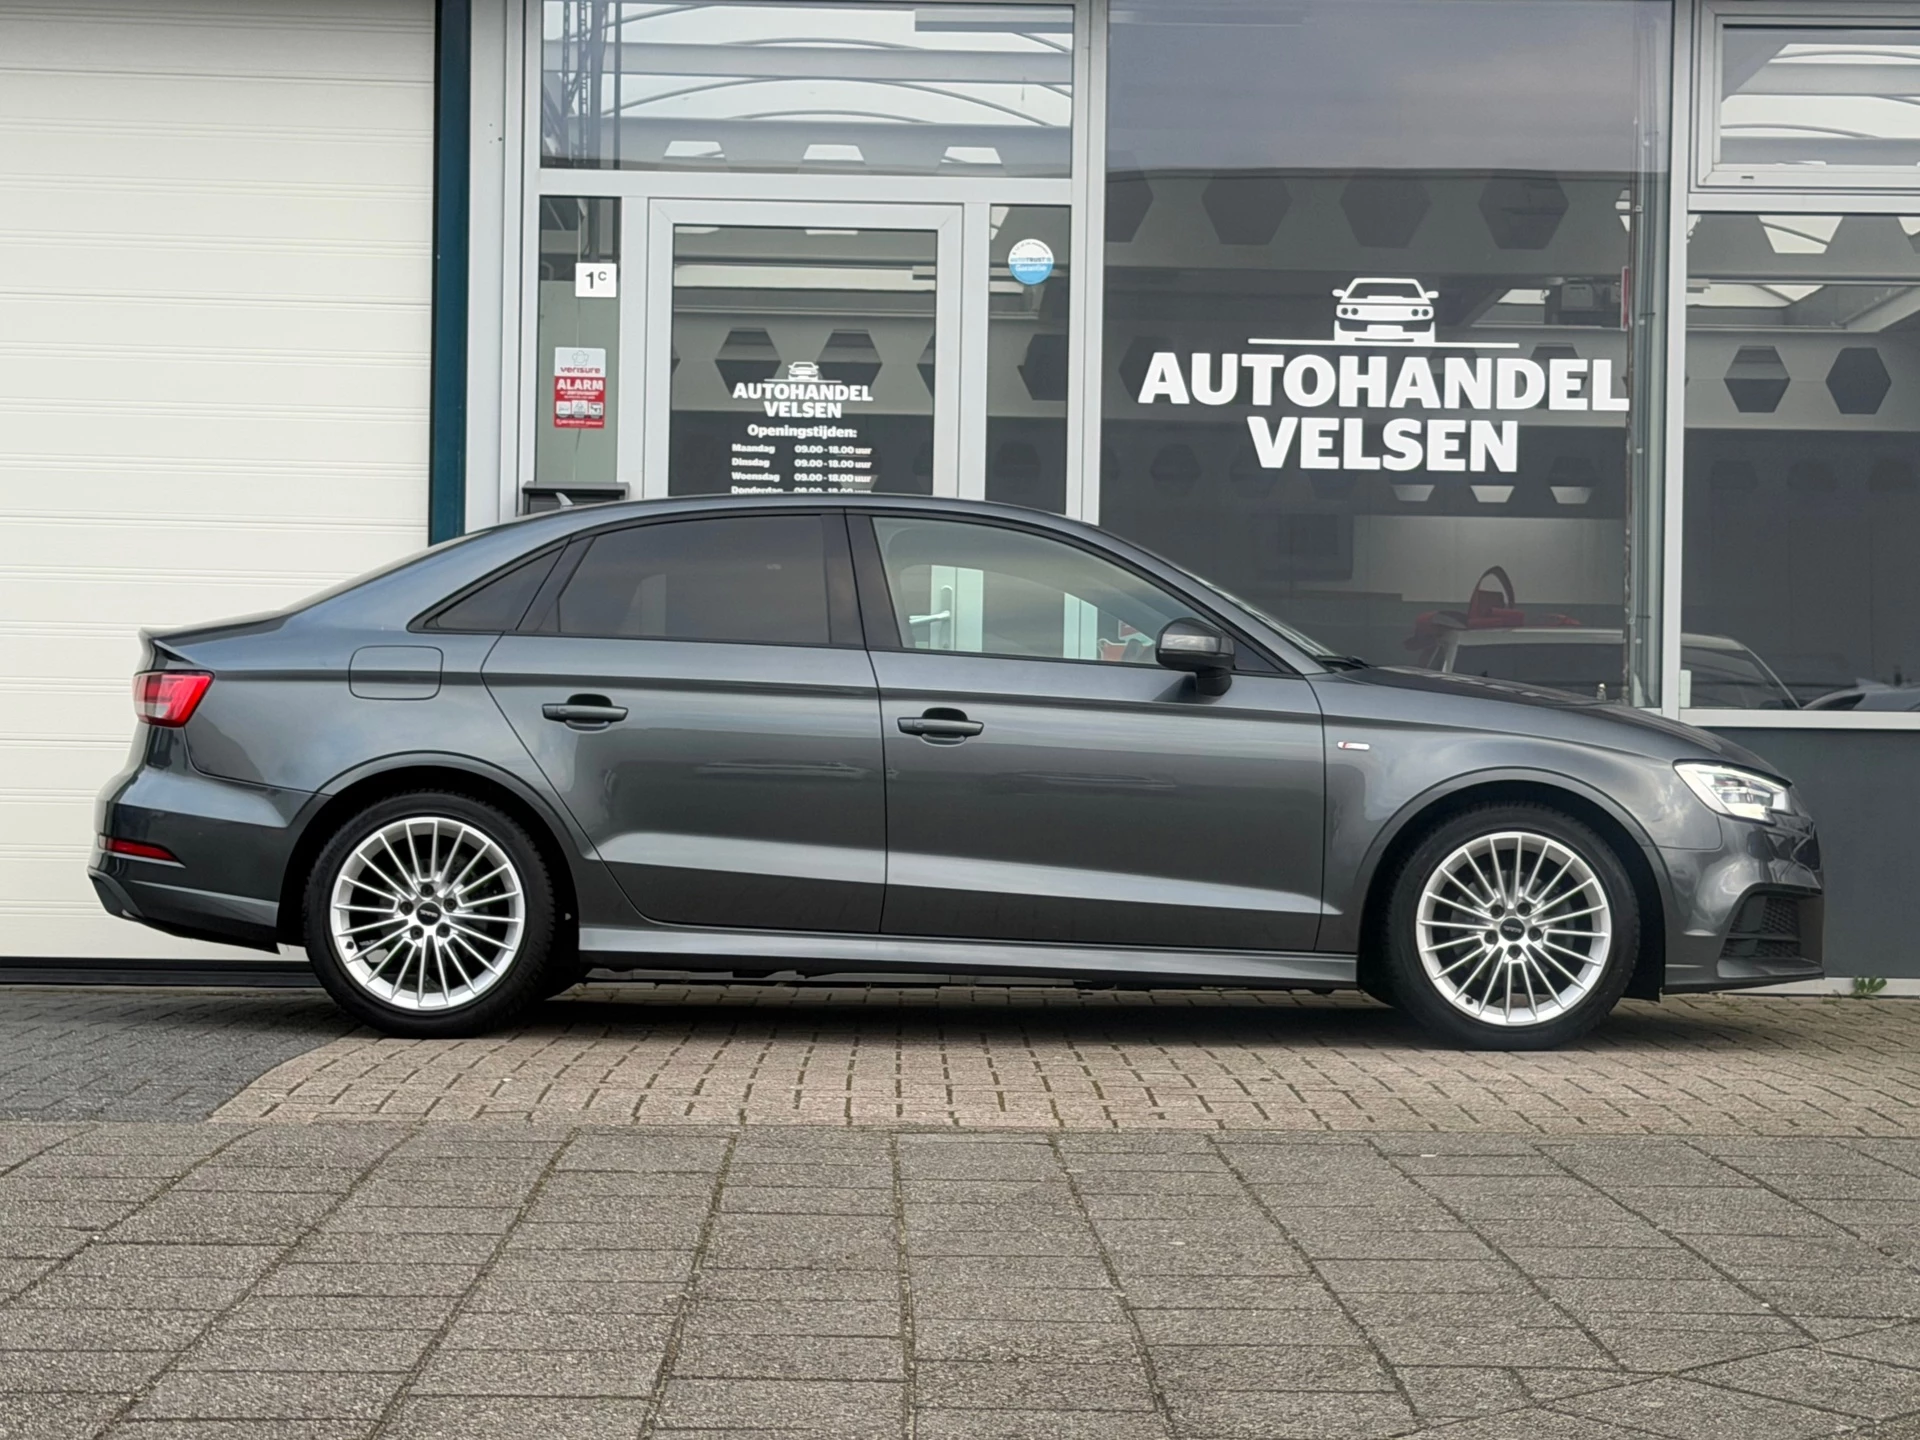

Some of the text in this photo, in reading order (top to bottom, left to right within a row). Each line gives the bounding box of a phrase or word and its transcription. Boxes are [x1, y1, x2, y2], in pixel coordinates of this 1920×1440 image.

[560, 366, 601, 374] verisure
[556, 378, 604, 391] ALARM
[1137, 351, 1630, 412] AUTOHANDEL
[732, 382, 874, 401] AUTOHANDEL
[763, 401, 842, 418] VELSEN
[747, 424, 857, 439] Openingstijden:
[731, 443, 776, 455] Maandag
[1247, 415, 1518, 473] VELSEN
[731, 457, 770, 468] Dinsdag
[731, 471, 780, 483] Woensdag
